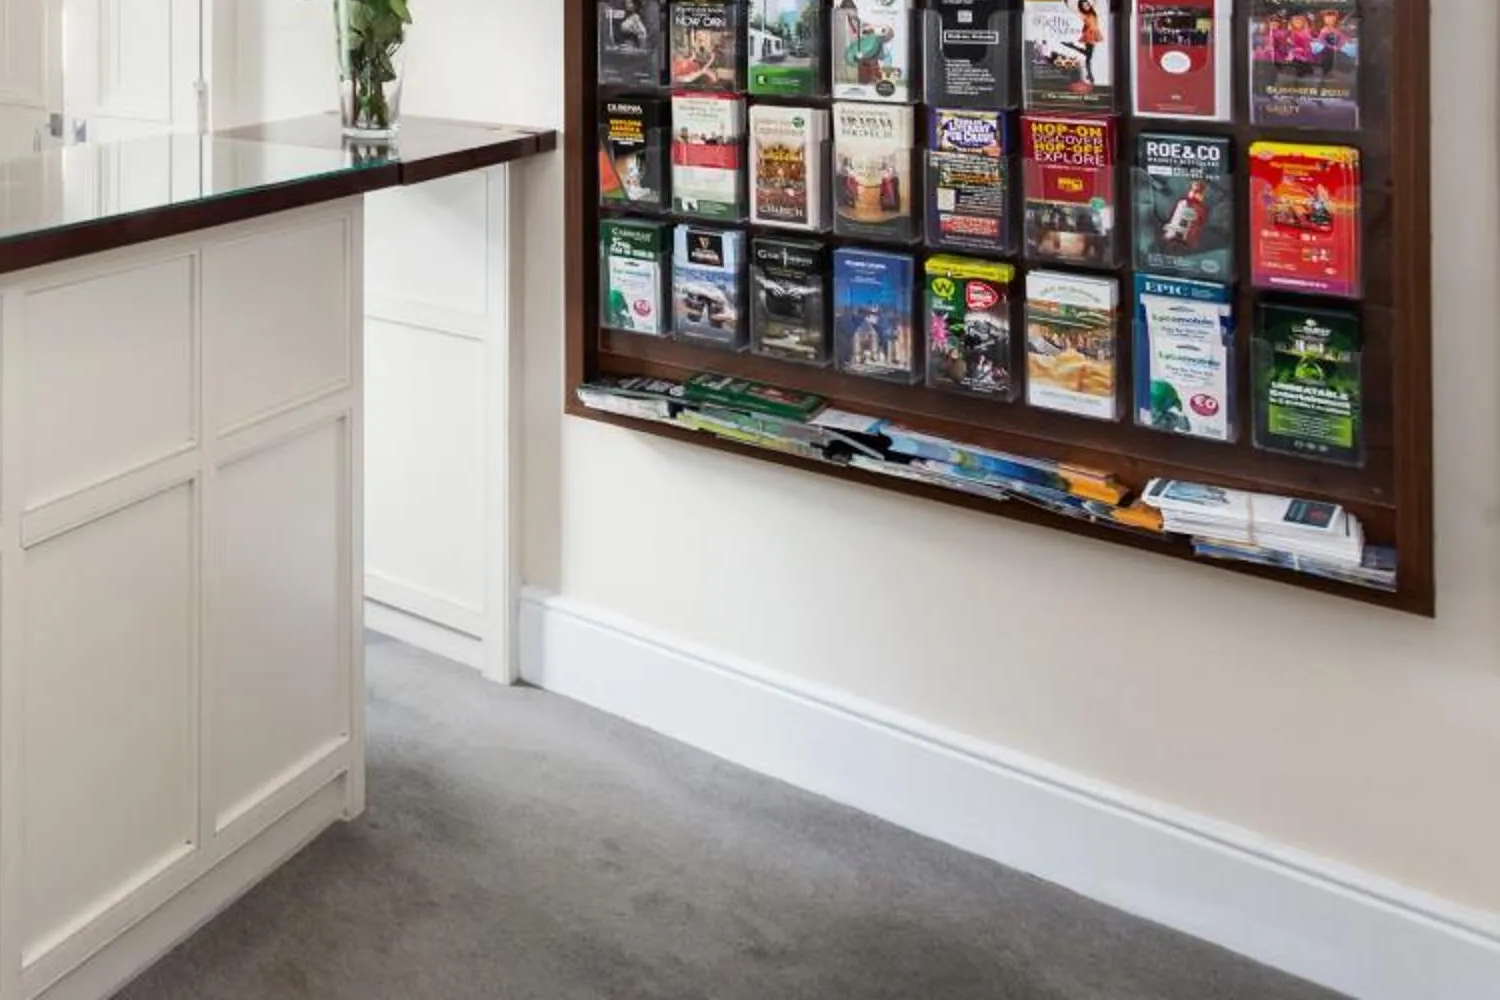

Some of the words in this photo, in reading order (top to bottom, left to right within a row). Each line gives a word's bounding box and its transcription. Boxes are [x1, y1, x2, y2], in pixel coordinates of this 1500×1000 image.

[1031, 123, 1102, 136] HOP-ON
[1033, 143, 1103, 153] HOP-OFF
[1035, 153, 1105, 167] EXPLORE
